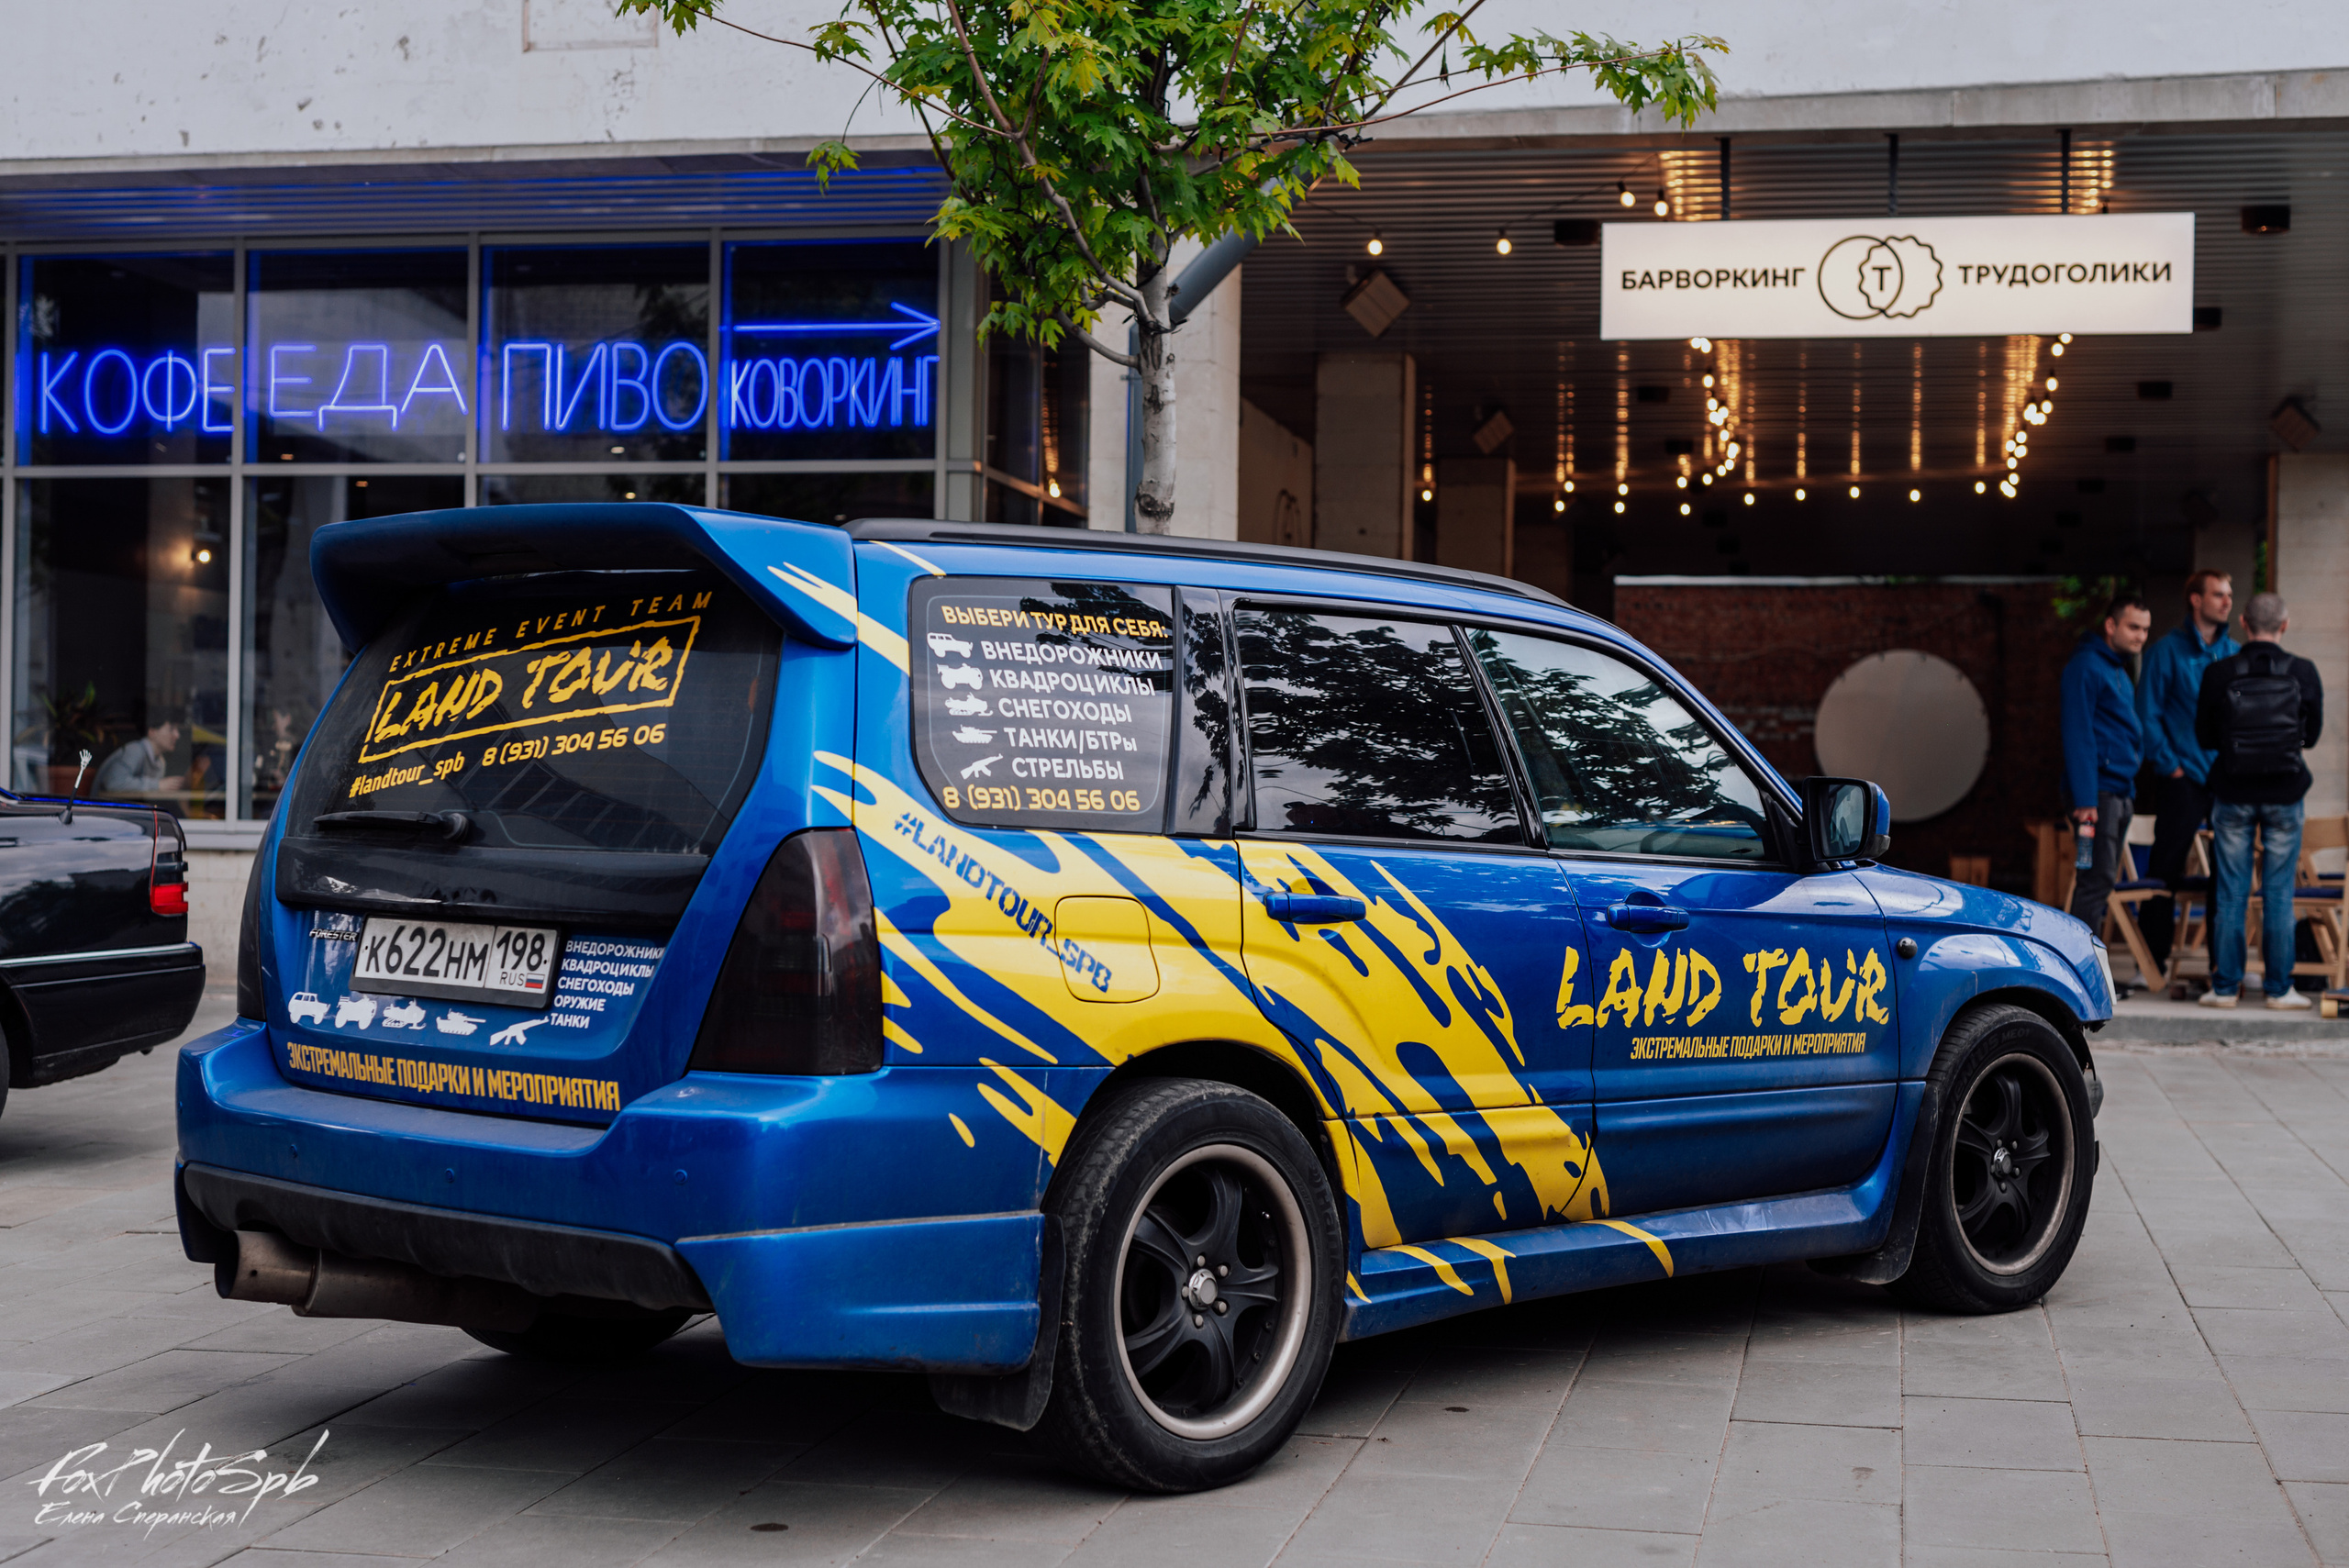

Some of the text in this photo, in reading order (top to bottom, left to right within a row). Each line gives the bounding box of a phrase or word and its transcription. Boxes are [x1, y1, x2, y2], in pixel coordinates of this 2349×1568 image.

[1620, 267, 1806, 291] БАРВОРКИНГ
[1958, 262, 2172, 289] ТРУДОГОЛИКИ
[40, 341, 941, 435] КОФЕ ЕДА ПИВО КОВОРКИНГ
[389, 591, 713, 673] EXTREME EVENT TEAM
[941, 606, 1169, 639] ВЫБЕРИ ТУР ДЛЯ СЕБЯ:
[980, 640, 1163, 671] ВНЕДОРОЖНИКИ
[373, 636, 674, 744] LAND TOUR
[989, 669, 1156, 697] КВАДРОЦИКЛЫ
[997, 697, 1132, 725] СНЕГОХОДЫ
[482, 723, 666, 767] 8 (931) 304 56 06
[1004, 727, 1138, 754] ТАНКИ/БТРы
[349, 751, 465, 798] #landtour_spb
[1011, 757, 1124, 781] СТРЕЛЬБЫ
[943, 784, 1141, 811] 8 (931) 304 56 06
[308, 928, 358, 942] FORESTER
[496, 931, 546, 972] 198
[565, 940, 666, 960] ВНЕДОРОЖНИКИ
[500, 972, 525, 986] RUS
[561, 958, 655, 978] КВАДРОЦИКЛЫ
[557, 976, 635, 997] СНЕГОХОДЫ
[1556, 945, 1889, 1029] LAND TOUR
[553, 995, 607, 1012] ОРУЖИЕ
[550, 1012, 591, 1029] ТАНКИ
[1630, 1032, 1866, 1060] ЭКСТРЕМАЛЬНЫЕ ПОДАРКИ И МЕРОПРИЯТИЯ
[286, 1041, 621, 1112] ЭКСТРЕМАЛЬНЫЕ ПОДАРКИ И МЕРОПРИЯТИЯ
